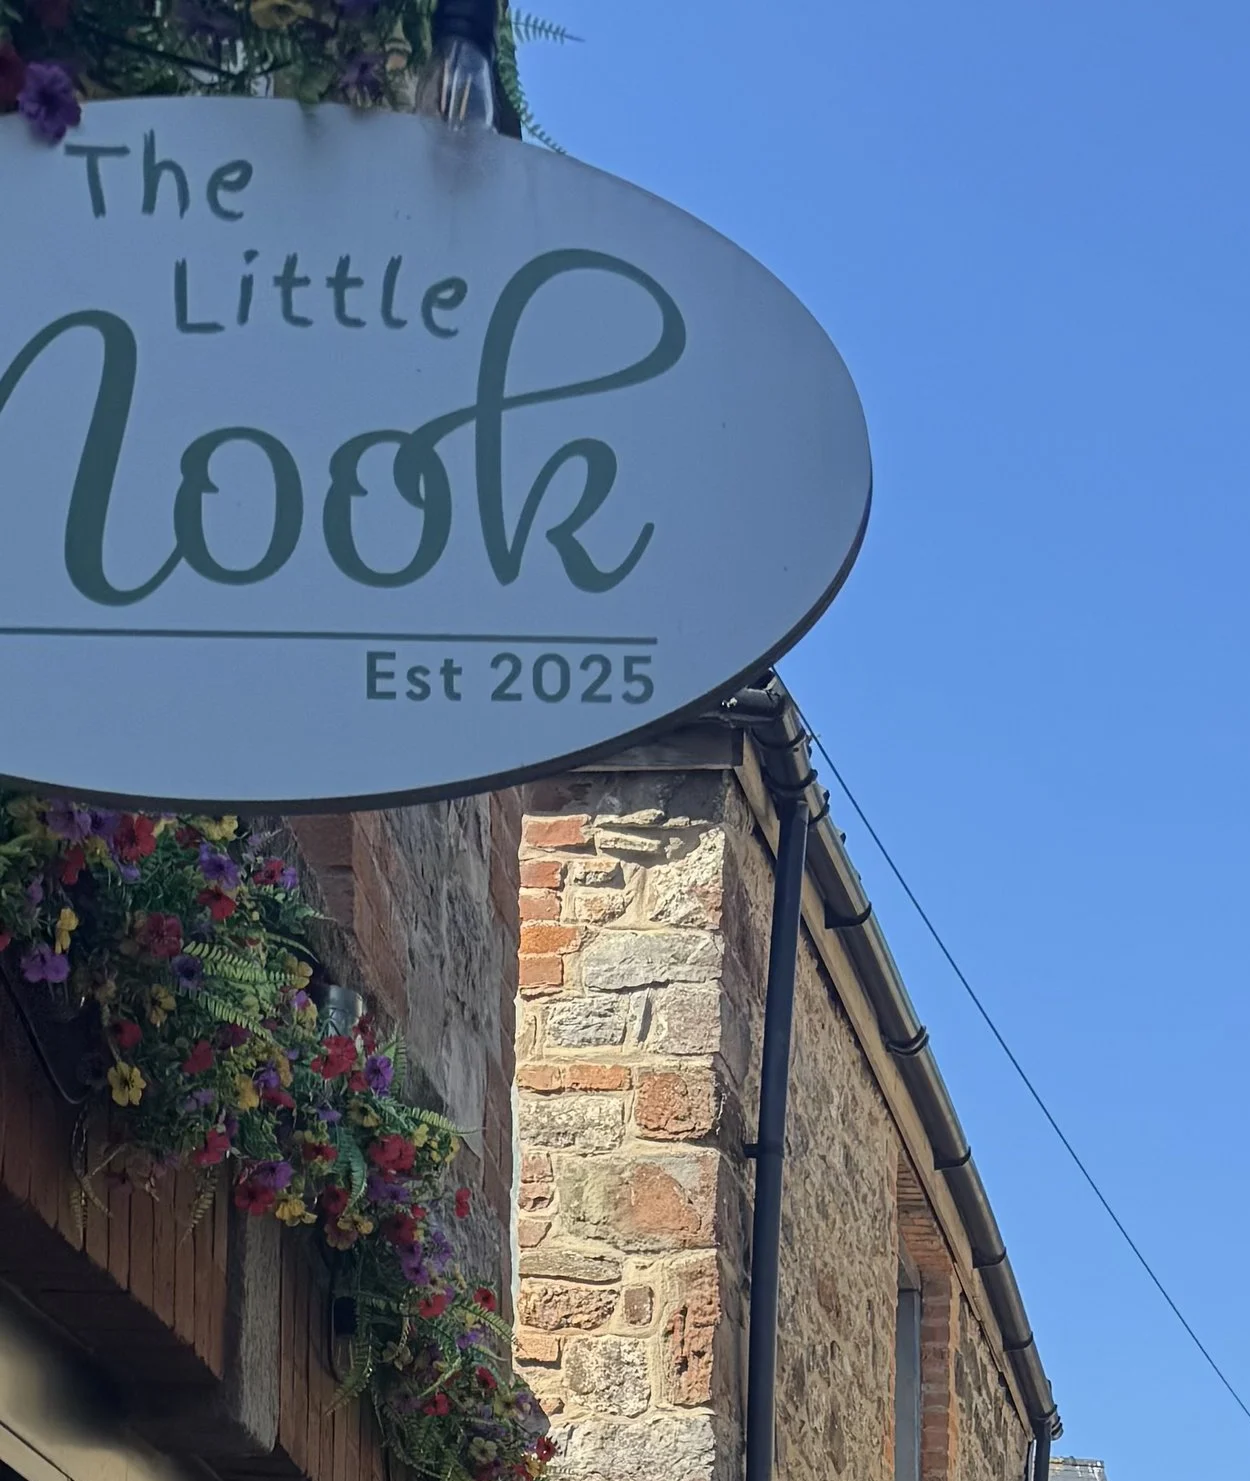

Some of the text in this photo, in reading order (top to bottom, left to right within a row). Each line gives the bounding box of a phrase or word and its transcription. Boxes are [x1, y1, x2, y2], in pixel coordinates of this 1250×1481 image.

[65, 129, 253, 221] The
[174, 250, 467, 338] Little
[366, 652, 655, 704] Est 2025
